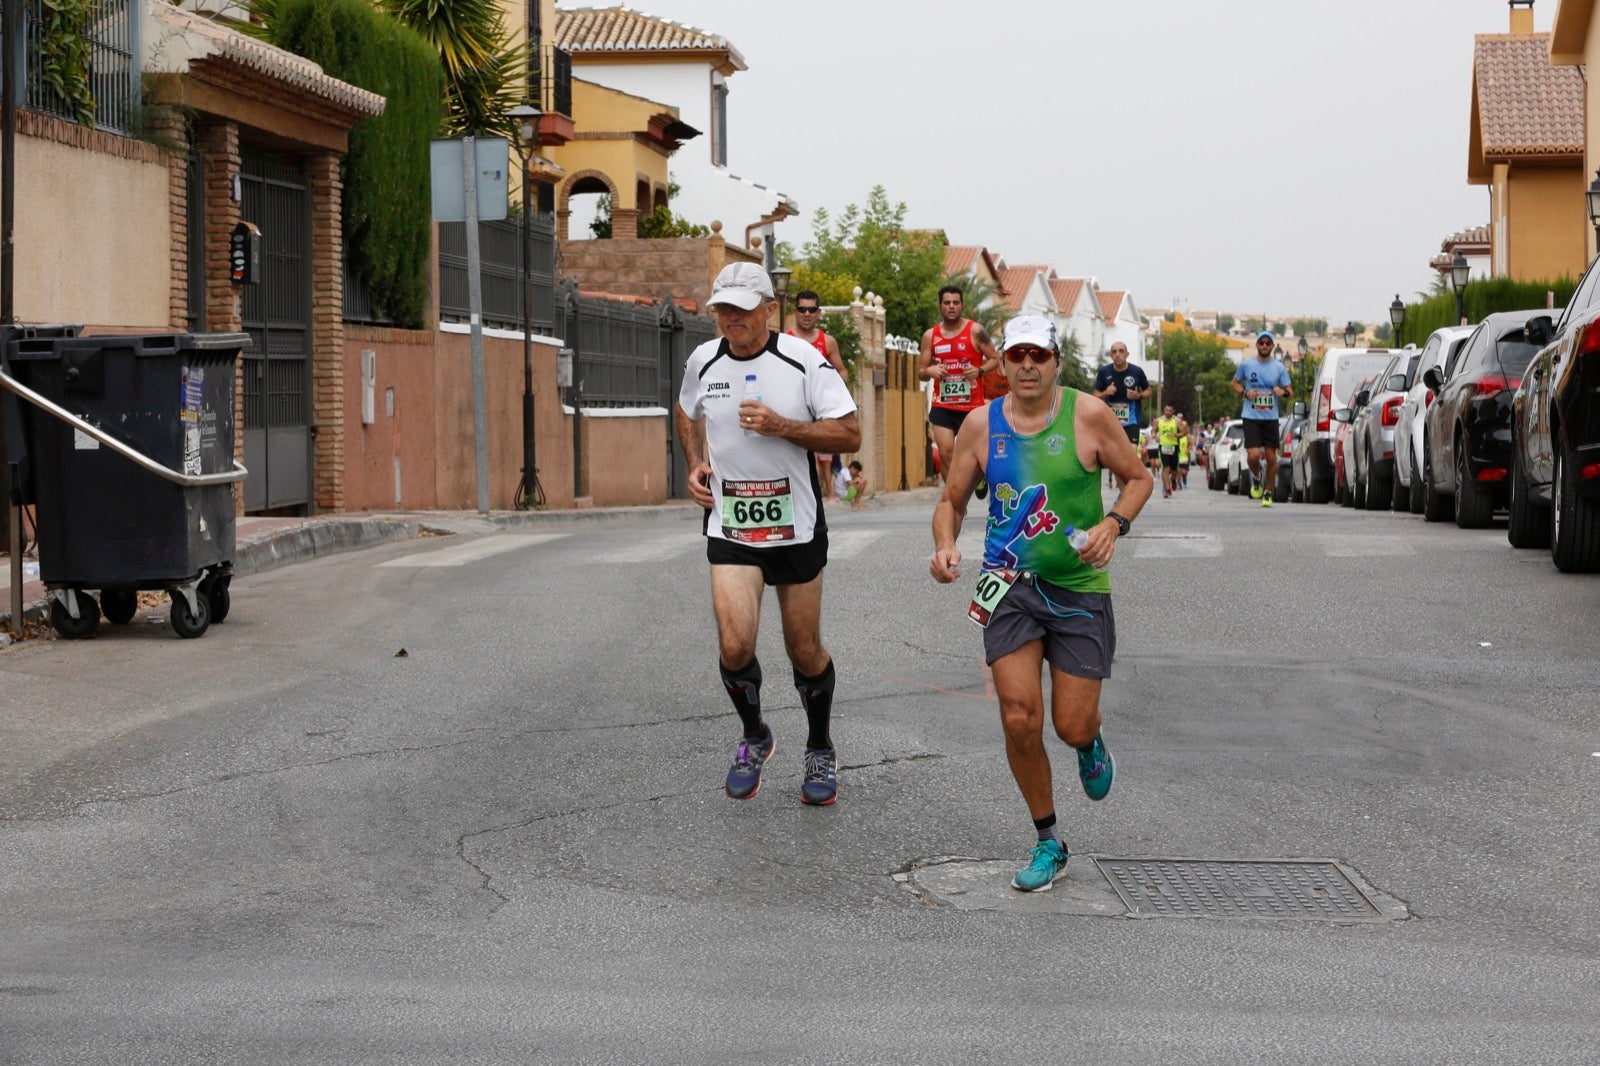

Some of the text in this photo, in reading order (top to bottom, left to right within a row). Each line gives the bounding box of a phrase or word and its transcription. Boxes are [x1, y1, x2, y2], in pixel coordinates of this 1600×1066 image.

[707, 382, 730, 392] joma
[944, 383, 966, 394] 624
[733, 499, 782, 524] 666
